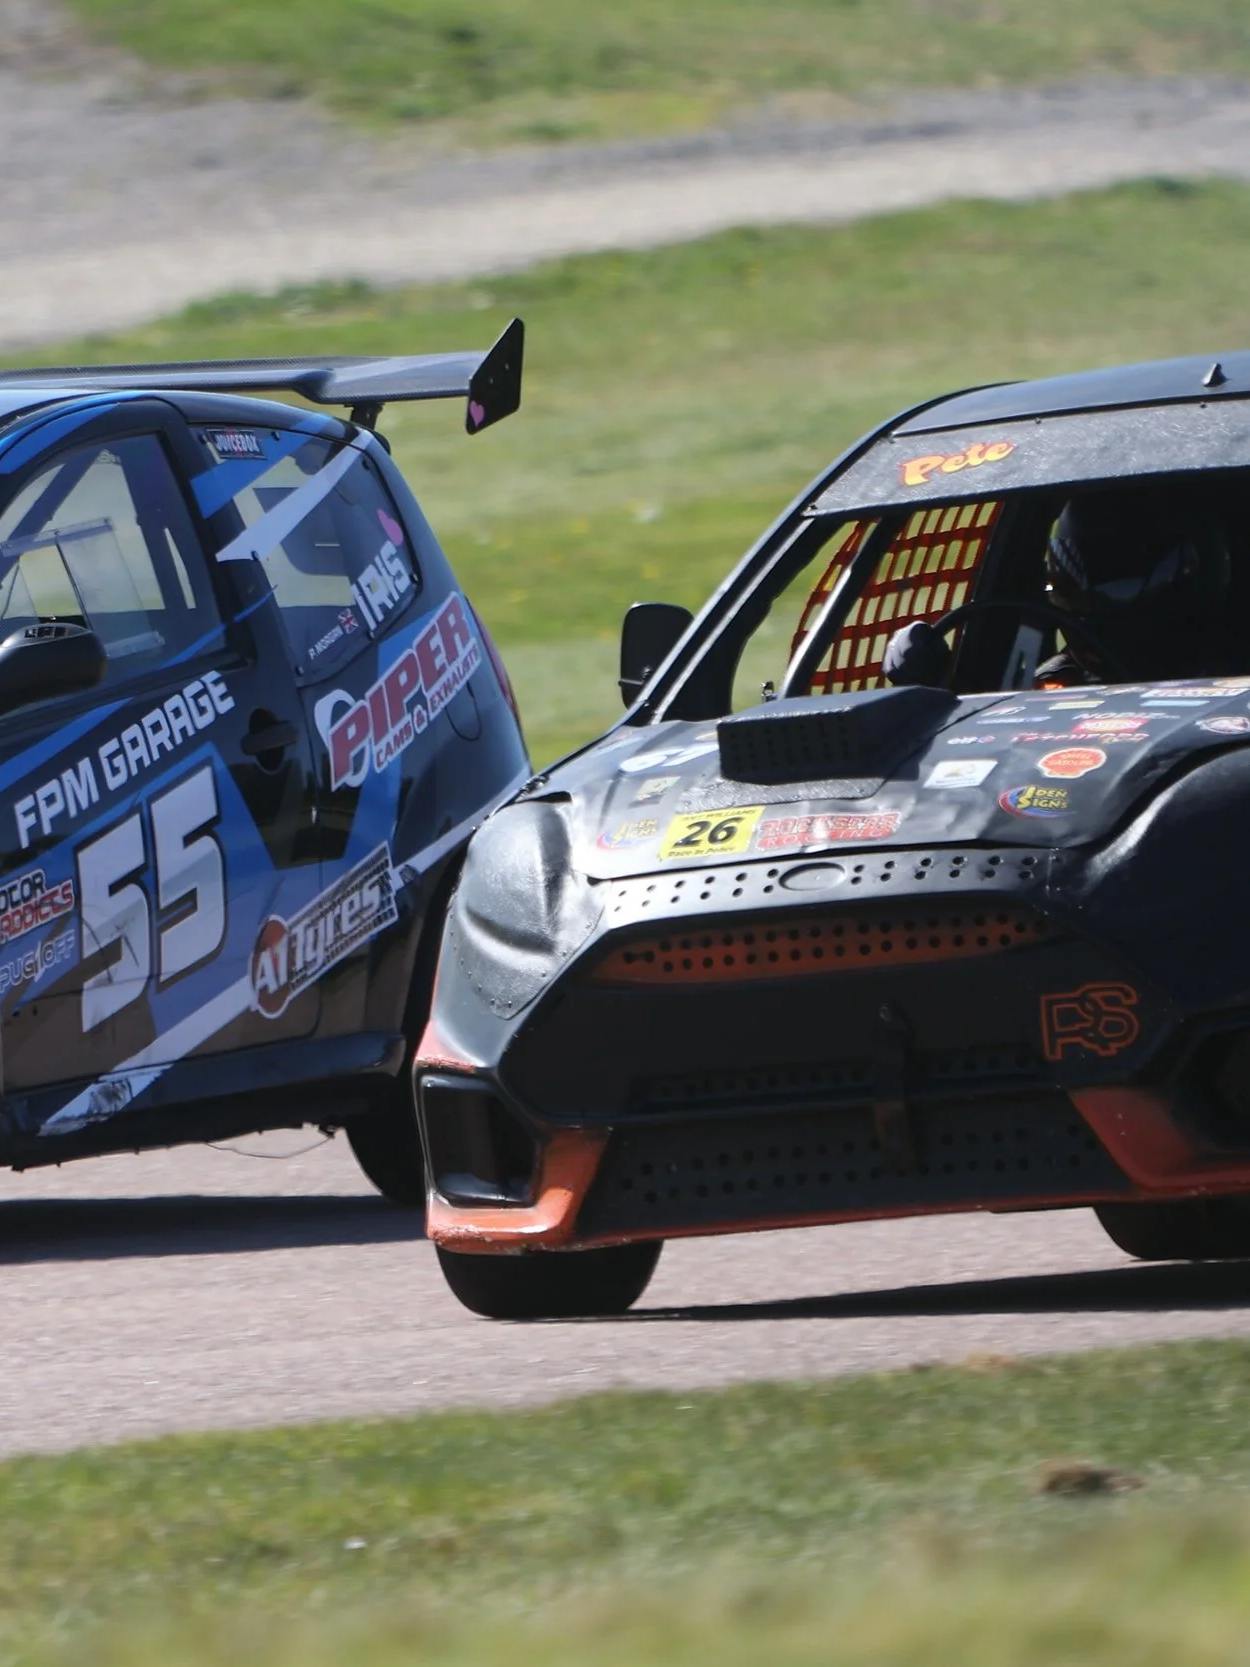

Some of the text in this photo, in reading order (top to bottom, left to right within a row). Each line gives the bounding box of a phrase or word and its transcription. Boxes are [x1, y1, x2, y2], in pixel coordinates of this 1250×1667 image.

[899, 440, 1018, 487] Pete
[350, 540, 411, 631] IRIS
[328, 592, 472, 792] PIPER
[14, 670, 236, 850] FPM GARAGE
[671, 816, 746, 849] 26
[76, 764, 228, 1034] 55
[291, 877, 382, 977] Tyres
